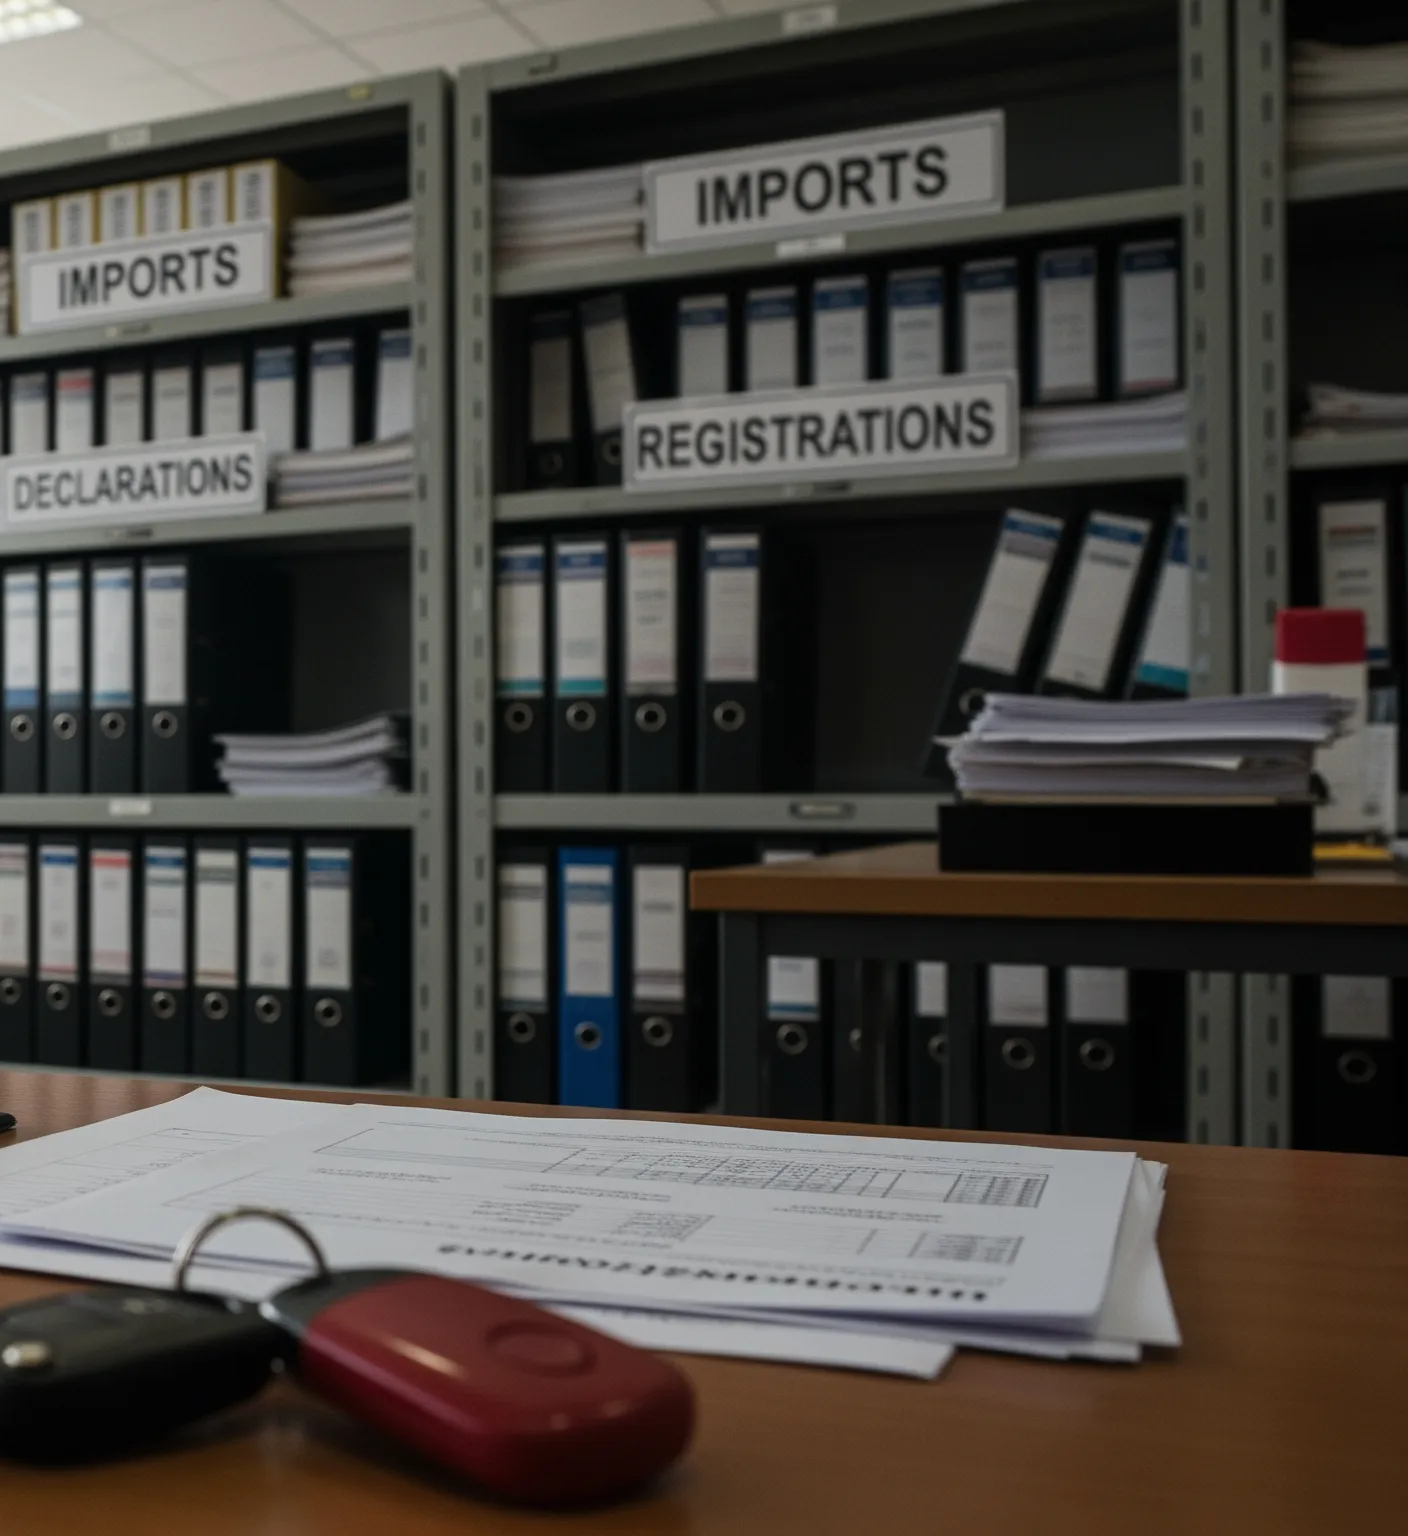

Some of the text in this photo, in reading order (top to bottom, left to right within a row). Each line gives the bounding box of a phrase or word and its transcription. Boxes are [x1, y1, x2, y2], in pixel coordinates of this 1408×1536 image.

[697, 146, 949, 226] IMPORTS
[58, 242, 240, 310] IMPORTS
[637, 398, 995, 471] REGISTRATIONS
[13, 453, 253, 511] DECLARATIONS
